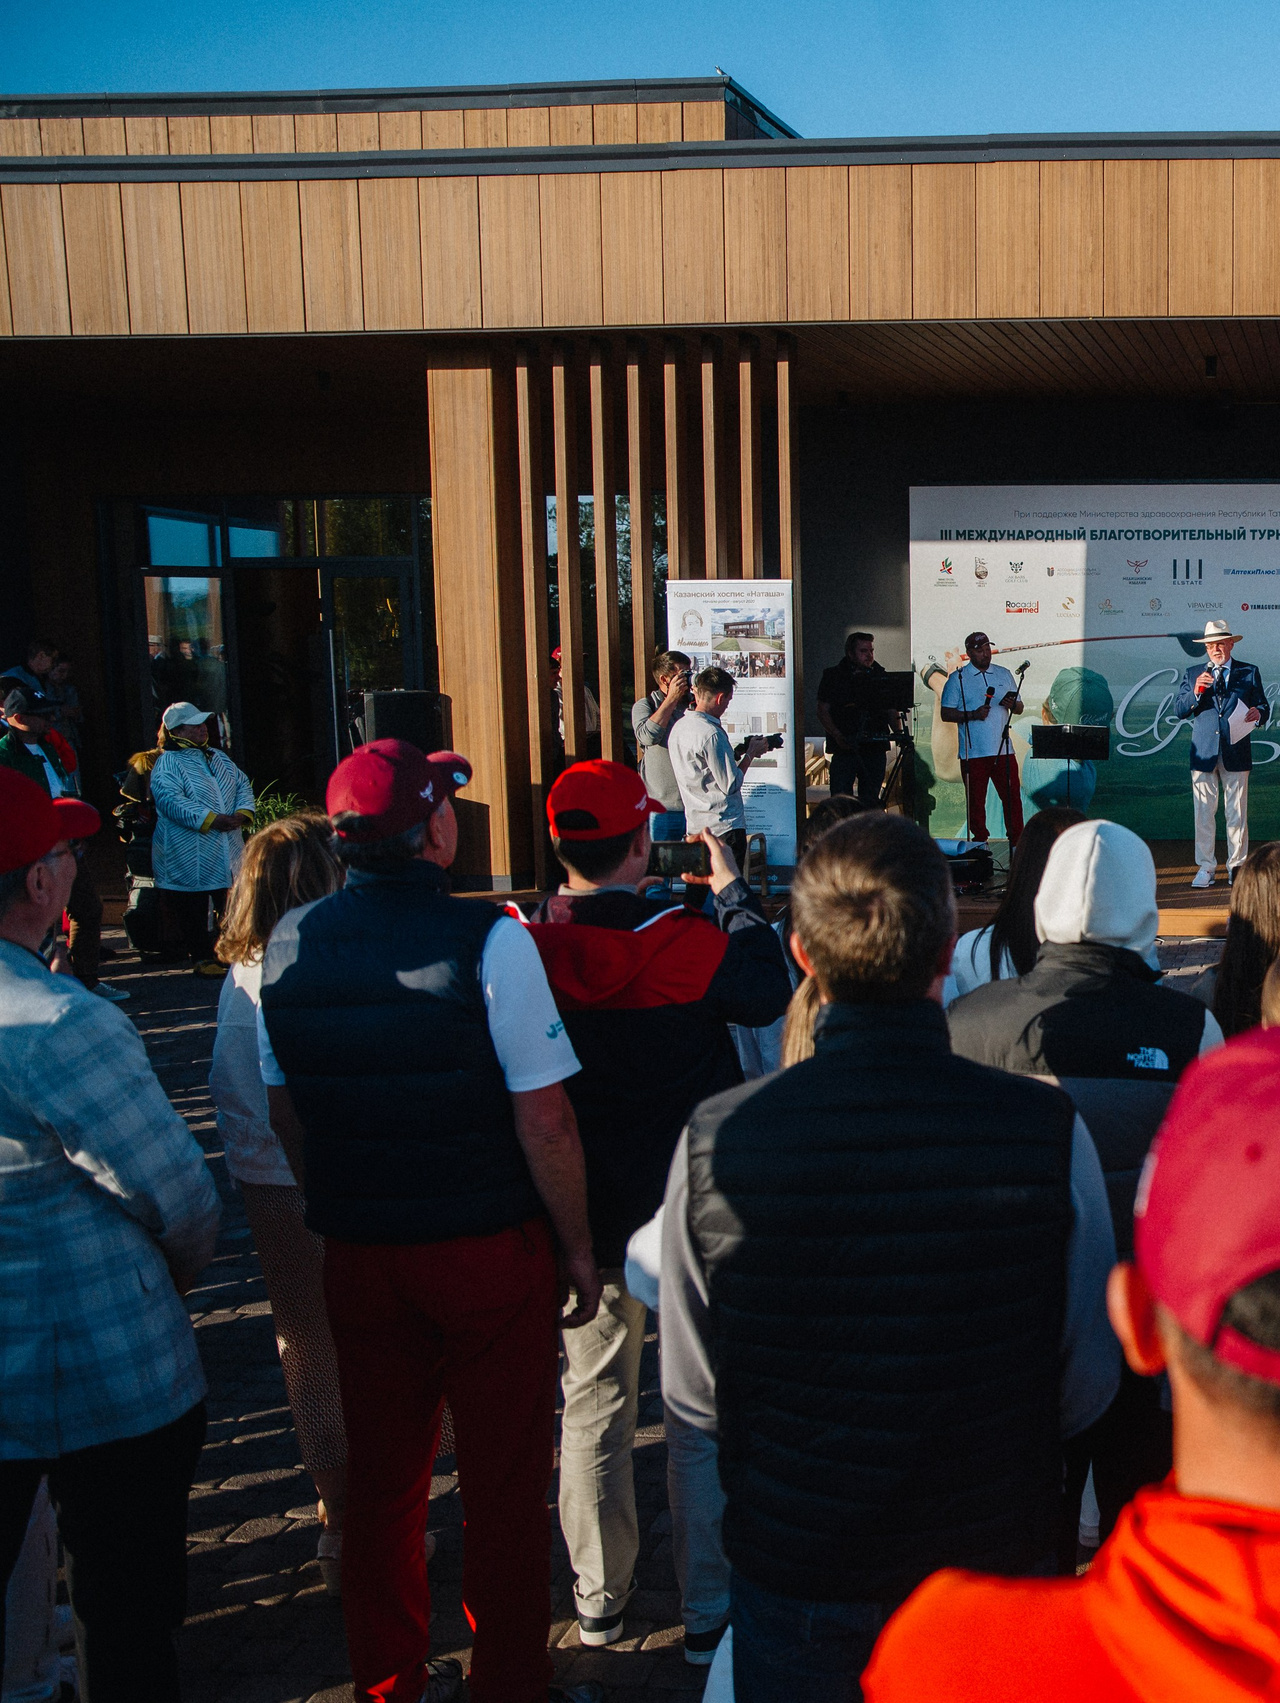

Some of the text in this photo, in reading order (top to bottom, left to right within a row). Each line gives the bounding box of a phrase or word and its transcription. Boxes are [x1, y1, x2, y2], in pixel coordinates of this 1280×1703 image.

[1014, 510, 1030, 519] При
[1032, 511, 1077, 519] поддержке
[1080, 510, 1138, 519] Министерства
[1141, 510, 1216, 518] здравоохранения
[1218, 510, 1266, 518] Республики
[940, 529, 952, 540] III
[955, 527, 1086, 542] МЕЖДУНАРОДНЫЙ
[1090, 526, 1246, 542] БЛАГОТВОРИТЕЛЬНЫЙ
[673, 590, 716, 598] Казанский
[747, 590, 785, 598] «Наташа»
[1005, 600, 1037, 609] Rocada
[1022, 604, 1039, 613] med
[1139, 1046, 1155, 1055] THE
[1126, 1053, 1155, 1062] NORTH
[1134, 1060, 1155, 1069] FACE
